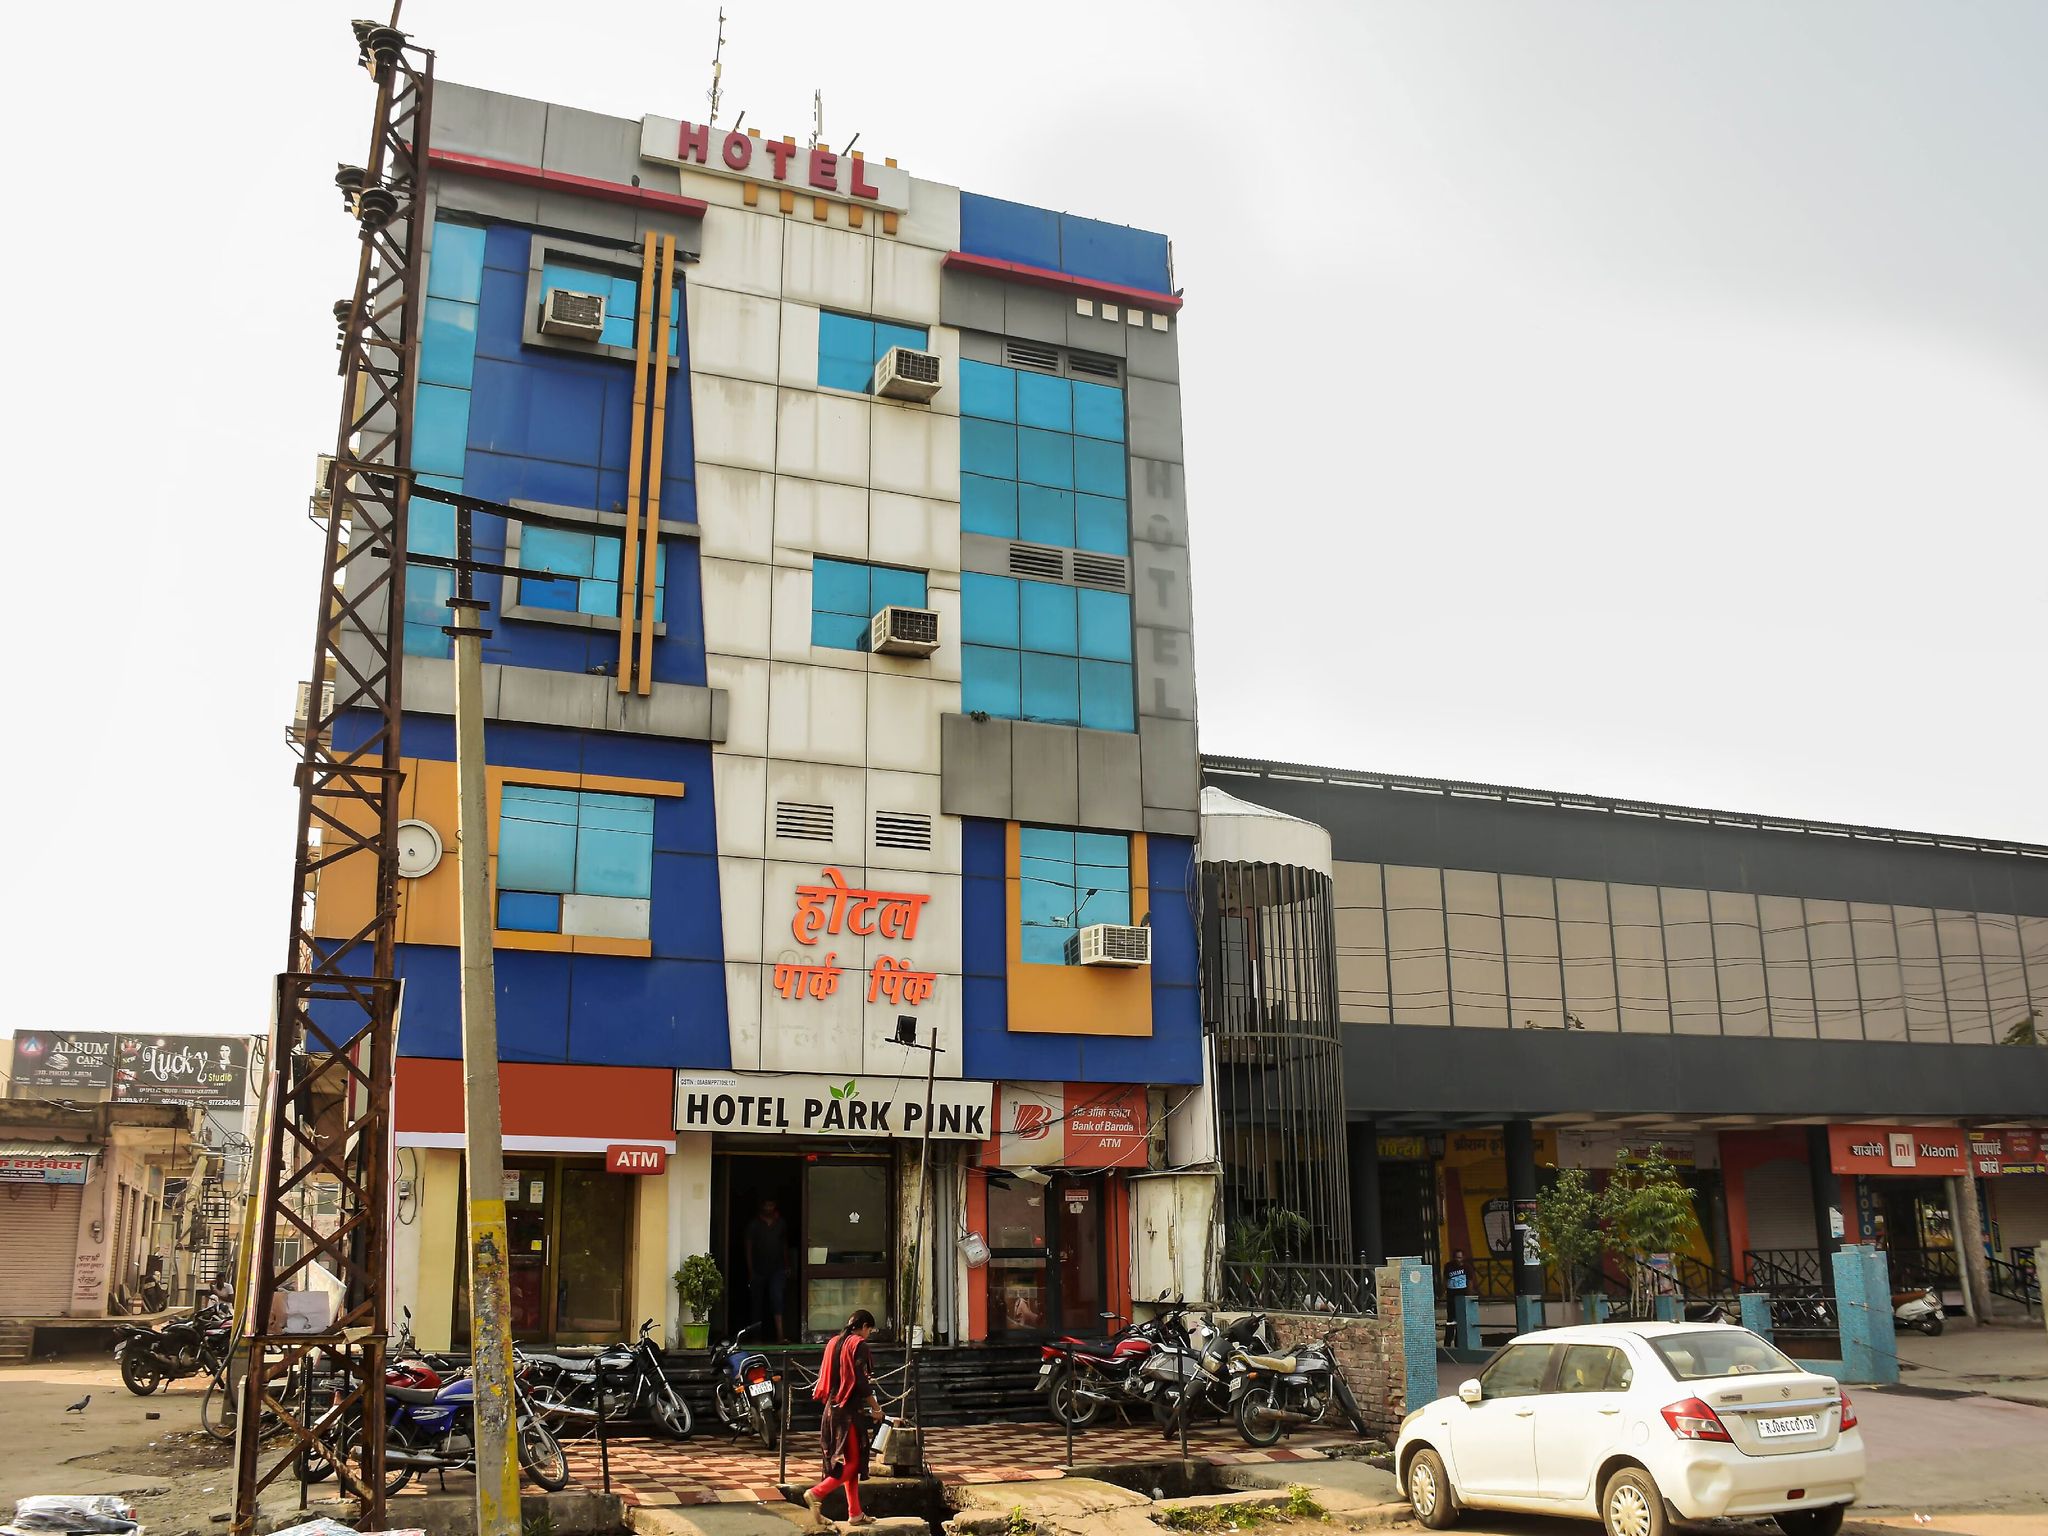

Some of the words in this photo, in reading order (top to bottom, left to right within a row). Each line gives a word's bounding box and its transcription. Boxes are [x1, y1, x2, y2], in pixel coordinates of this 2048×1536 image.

[678, 120, 879, 200] HOTEL
[1145, 460, 1182, 718] HOTEL
[793, 867, 932, 945] होटल
[774, 952, 844, 1000] पार्क
[868, 955, 937, 1006] पिंक
[51, 1041, 109, 1055] ALBUM
[142, 1045, 209, 1083] Lucky
[208, 1073, 233, 1082] Studio
[686, 1093, 790, 1127] HOTEL
[803, 1098, 892, 1131] PARK
[903, 1102, 985, 1134] PINK
[1072, 1121, 1094, 1131] Bank
[1095, 1121, 1105, 1131] of
[1105, 1121, 1134, 1132] Baroda
[1099, 1138, 1121, 1148] ATM
[1920, 1144, 1959, 1158] Xiaomi
[616, 1151, 658, 1168] ATM
[1766, 1418, 1815, 1433] RJ06CC0139
